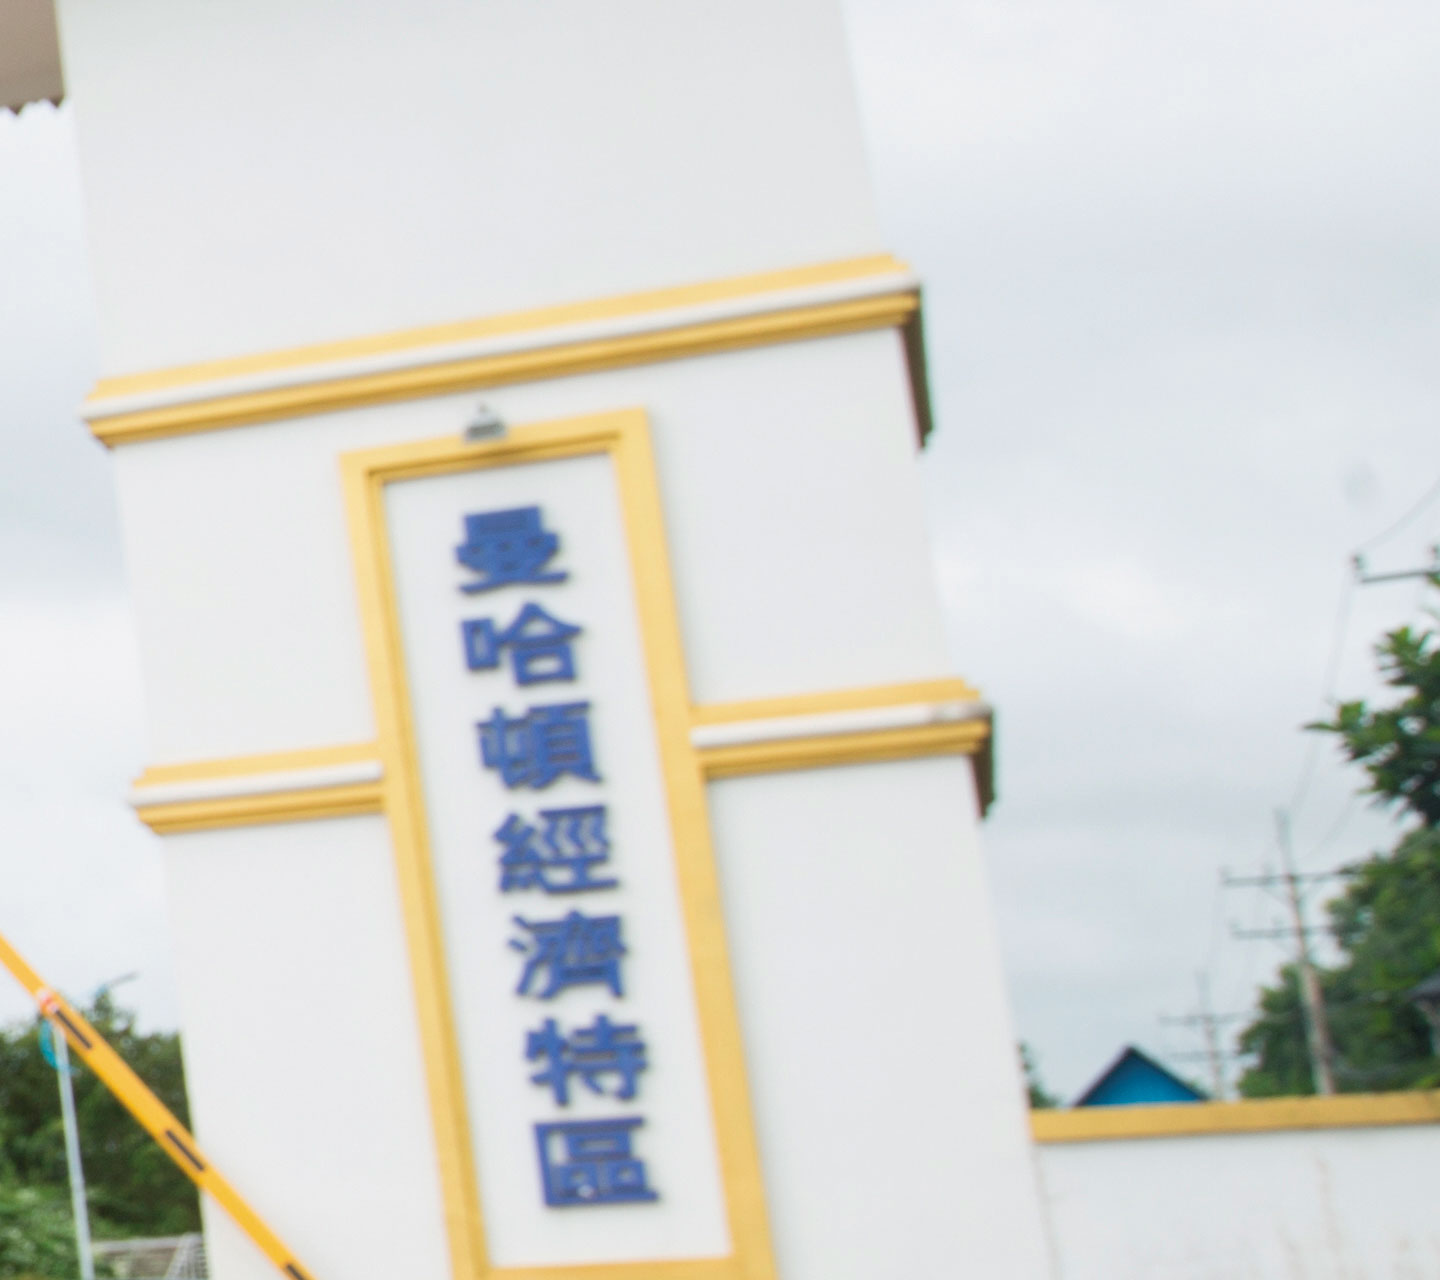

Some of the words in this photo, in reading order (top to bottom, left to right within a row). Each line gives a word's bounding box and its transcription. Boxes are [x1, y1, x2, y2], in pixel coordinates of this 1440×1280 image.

[453, 505, 660, 1210] 曼哈頓經濟特區
